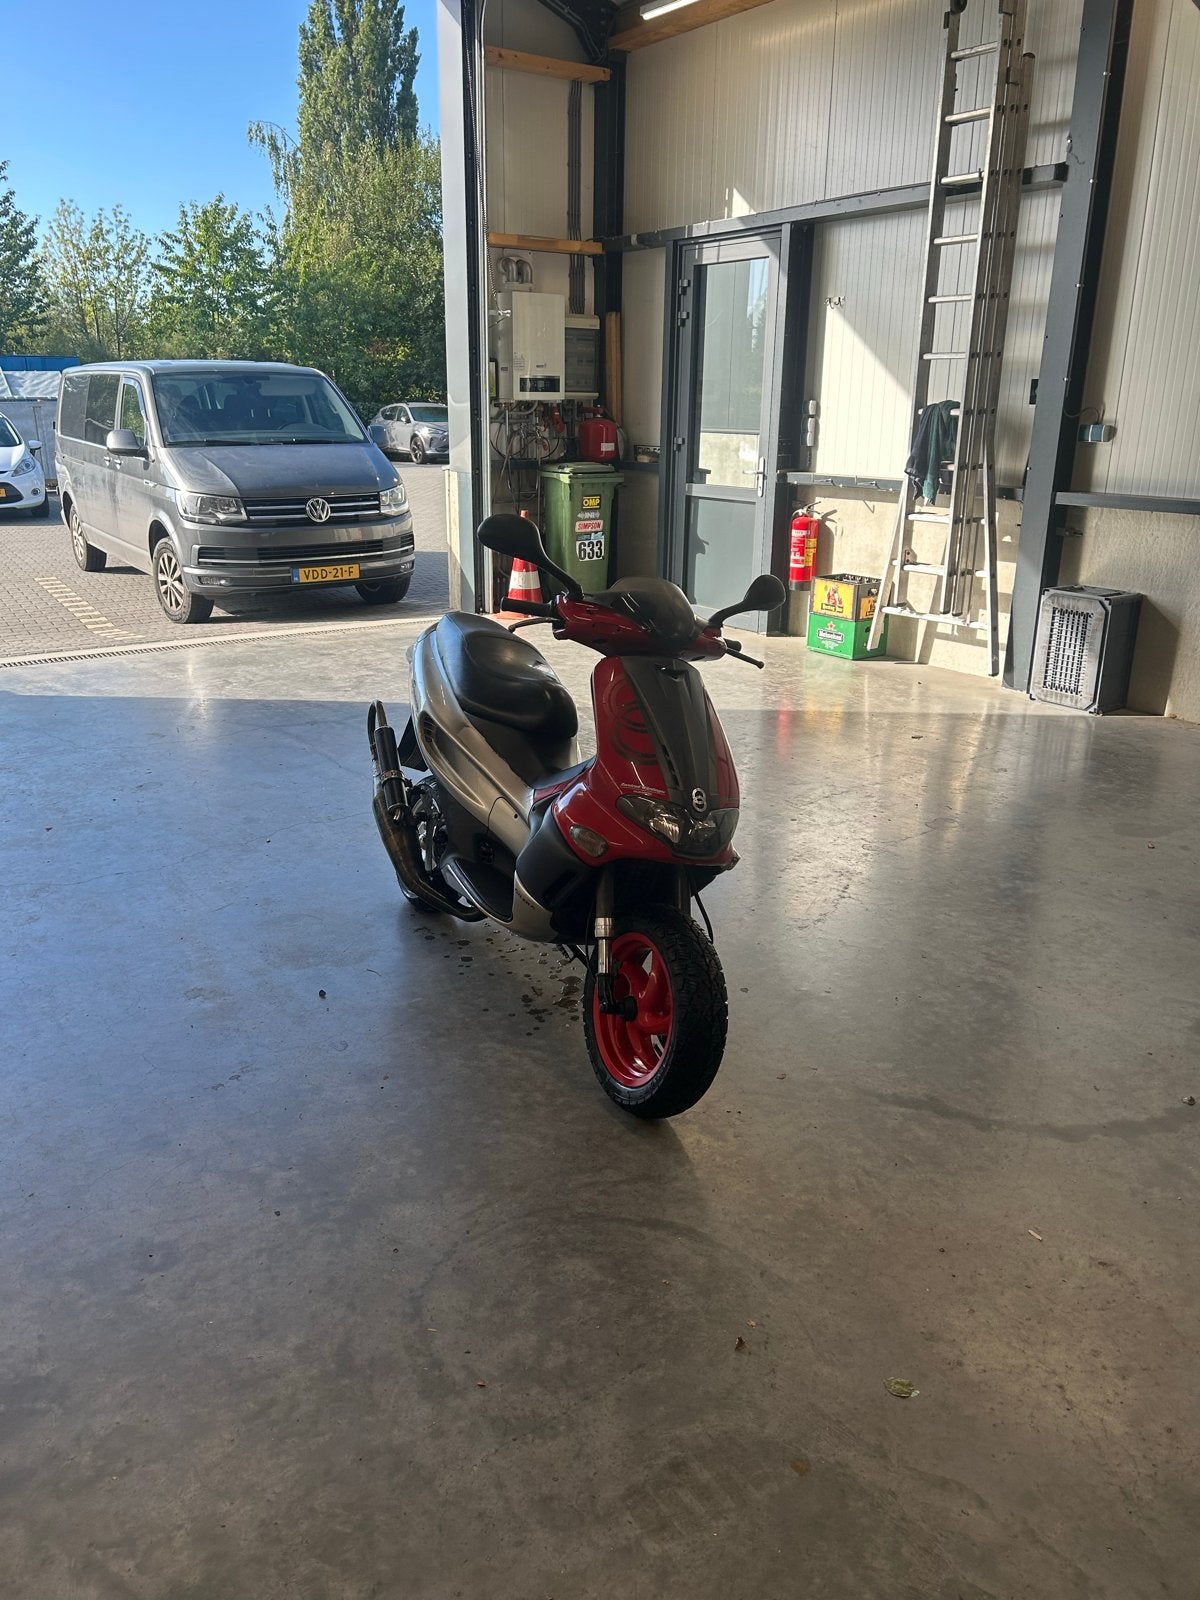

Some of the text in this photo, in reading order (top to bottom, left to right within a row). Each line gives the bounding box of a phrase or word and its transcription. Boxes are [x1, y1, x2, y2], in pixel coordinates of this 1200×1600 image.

[583, 498, 600, 507] OMP
[577, 521, 602, 531] SIMPSON
[578, 540, 603, 560] 633
[303, 566, 354, 581] VDD-21-F
